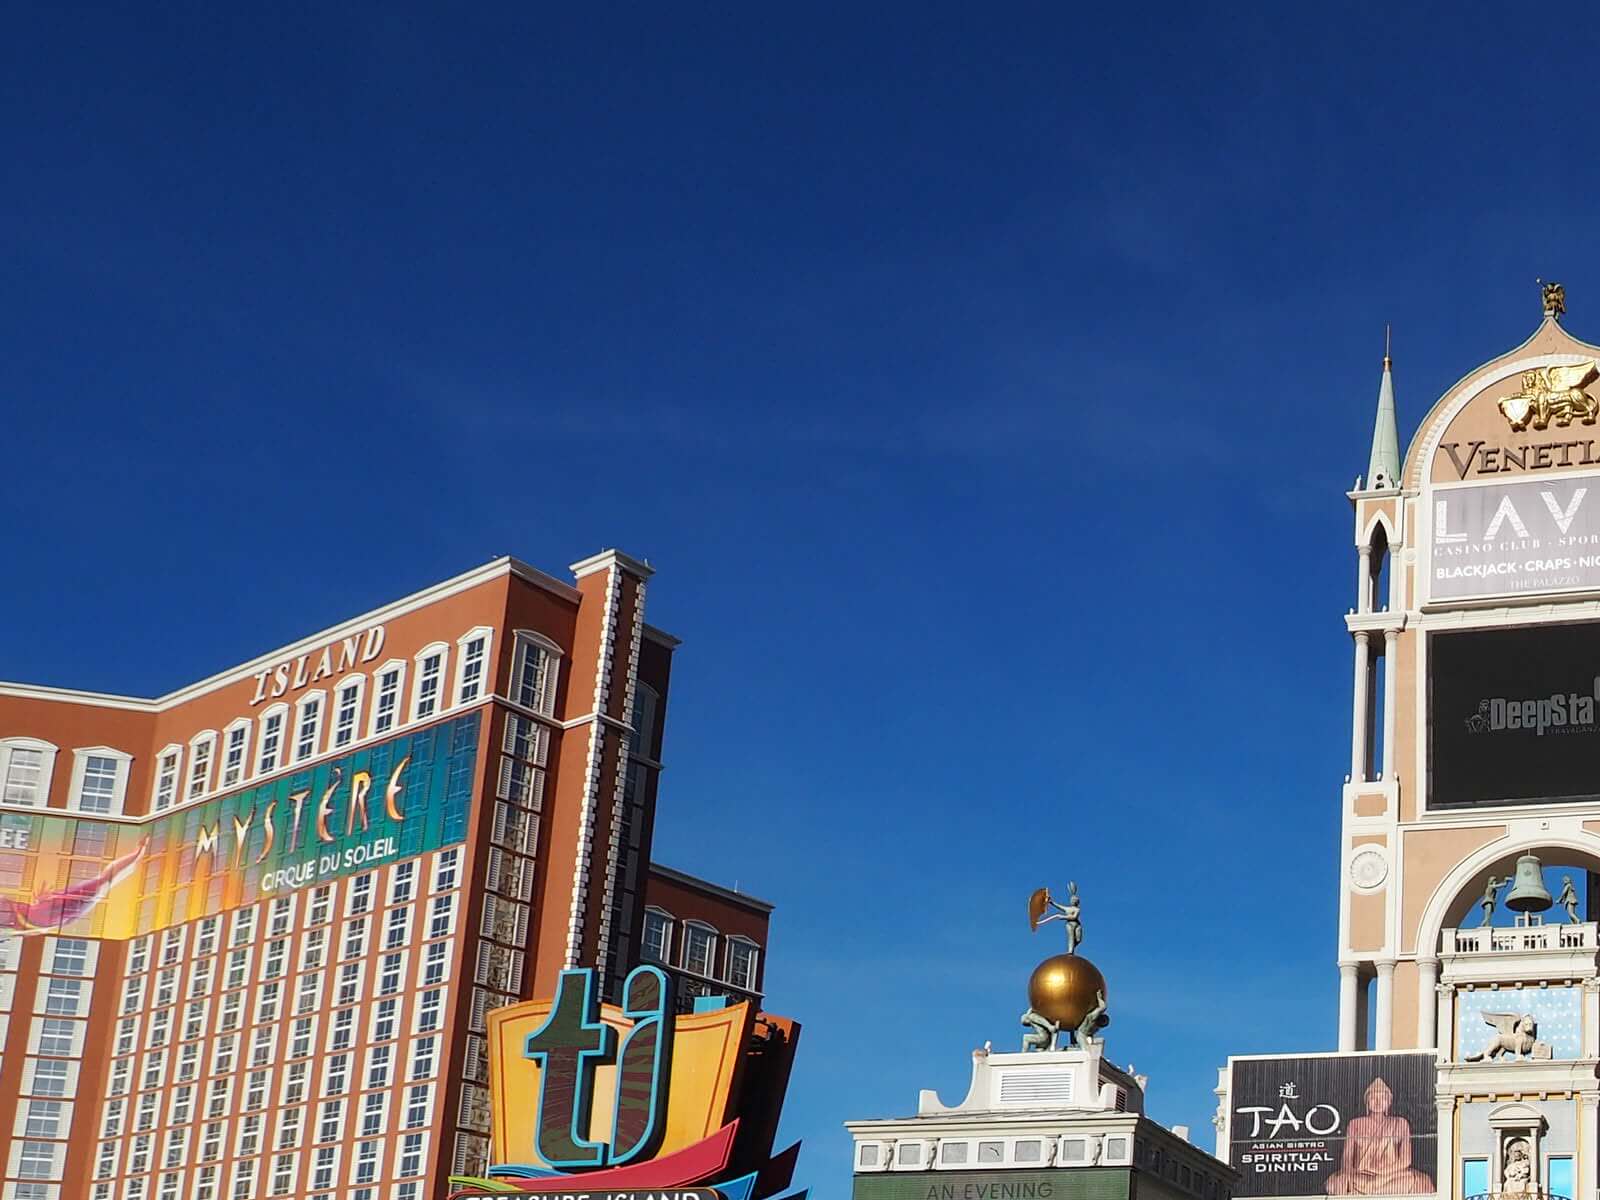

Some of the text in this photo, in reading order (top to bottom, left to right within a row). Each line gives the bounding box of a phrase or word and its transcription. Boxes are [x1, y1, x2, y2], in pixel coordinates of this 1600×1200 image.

[1434, 542, 1493, 557] CASINO
[1500, 538, 1541, 551] CLUB
[1436, 561, 1516, 580] BLACKJACK
[1524, 557, 1571, 573] CRAPS
[1533, 575, 1580, 588] PALAZZO
[249, 624, 385, 706] ISLAND
[262, 837, 399, 892] CIRQUE DU SOLEIL
[1279, 1081, 1300, 1099] 道
[1236, 1103, 1341, 1139] TAO
[1252, 1140, 1325, 1149] ASIAN BISTRO
[1241, 1151, 1334, 1164] SPIRITUAL
[1255, 1162, 1319, 1173] DINING
[926, 1181, 1053, 1200] AN EVENING
